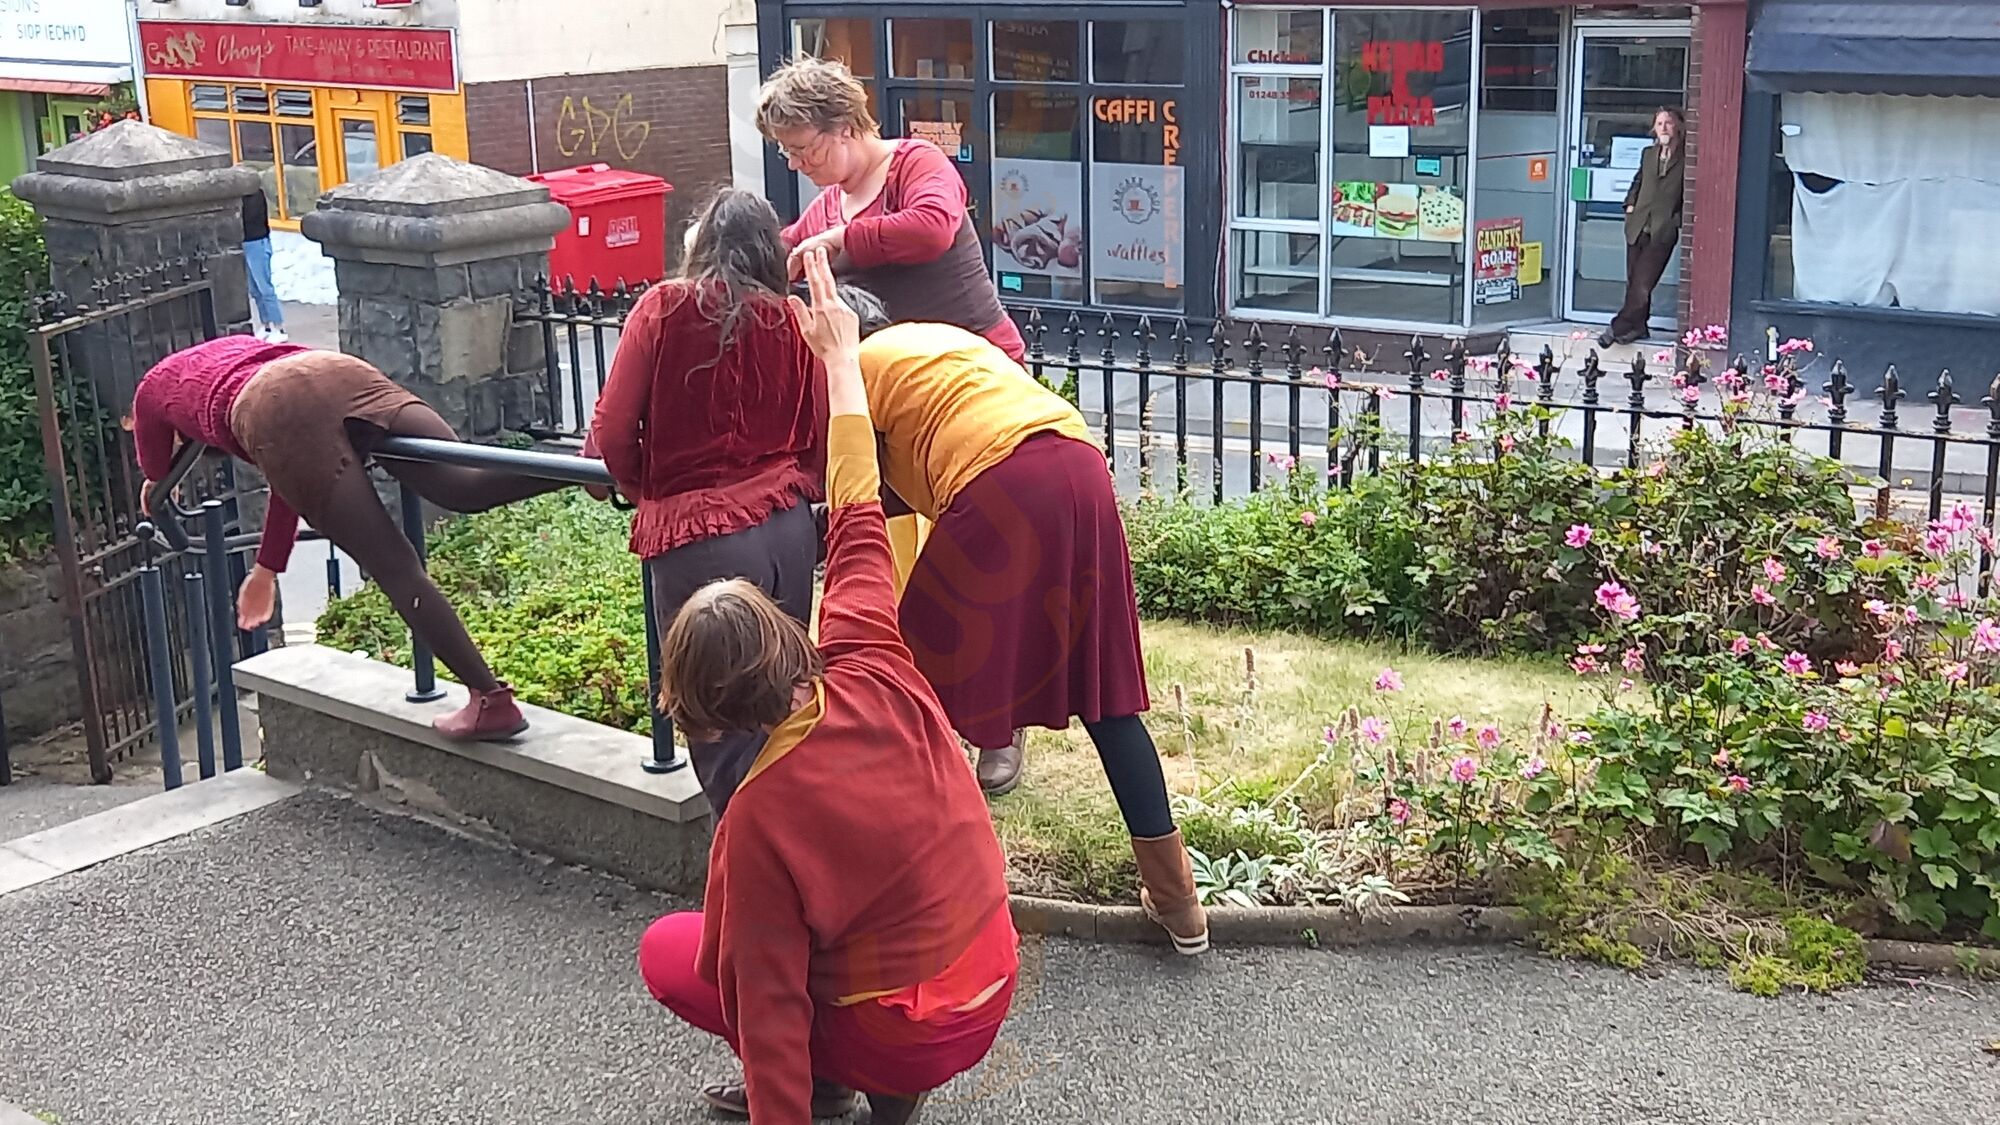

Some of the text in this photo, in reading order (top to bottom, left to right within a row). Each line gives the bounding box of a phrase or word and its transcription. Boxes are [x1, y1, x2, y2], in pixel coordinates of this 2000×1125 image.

[16, 23, 87, 42] SIOP IECHYD
[368, 39, 446, 62] RESTAURANT
[1362, 41, 1444, 72] KEBAB
[1095, 99, 1156, 124] CAFFI
[1367, 96, 1435, 127] PIZZA
